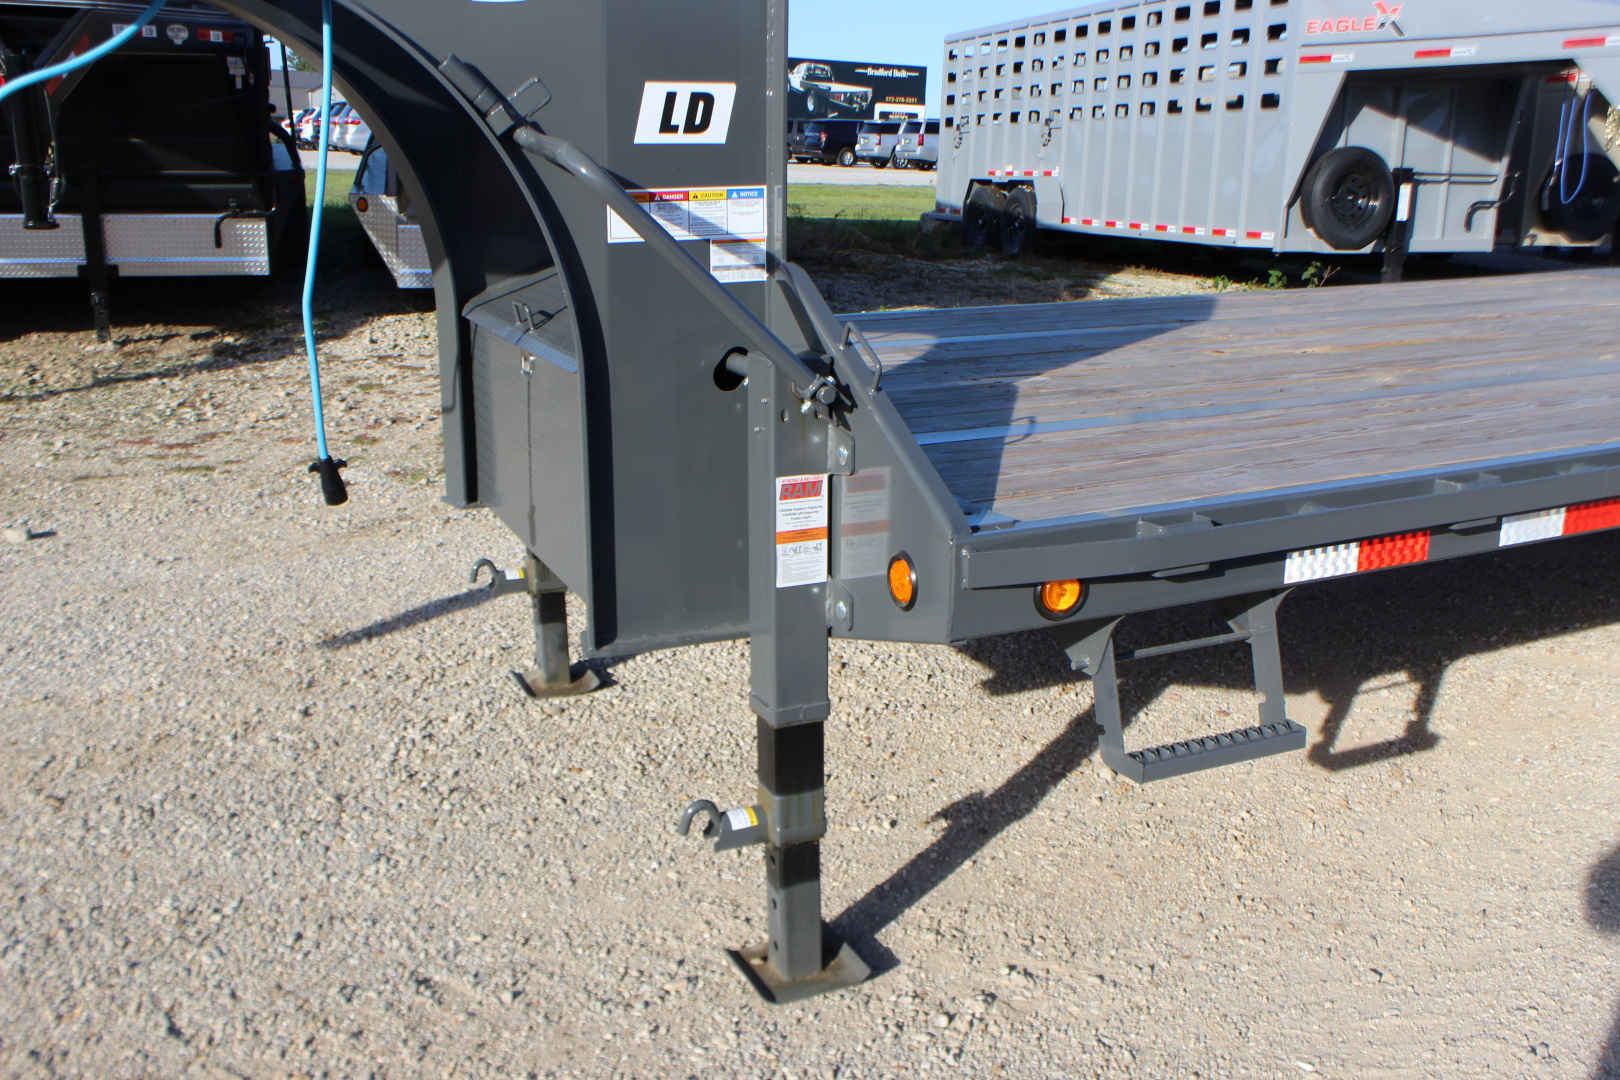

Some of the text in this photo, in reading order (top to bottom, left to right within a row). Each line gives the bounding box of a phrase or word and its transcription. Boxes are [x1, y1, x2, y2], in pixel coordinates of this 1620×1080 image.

[867, 66, 892, 77] Bradford
[658, 91, 715, 135] LD
[781, 481, 823, 500] RAM
